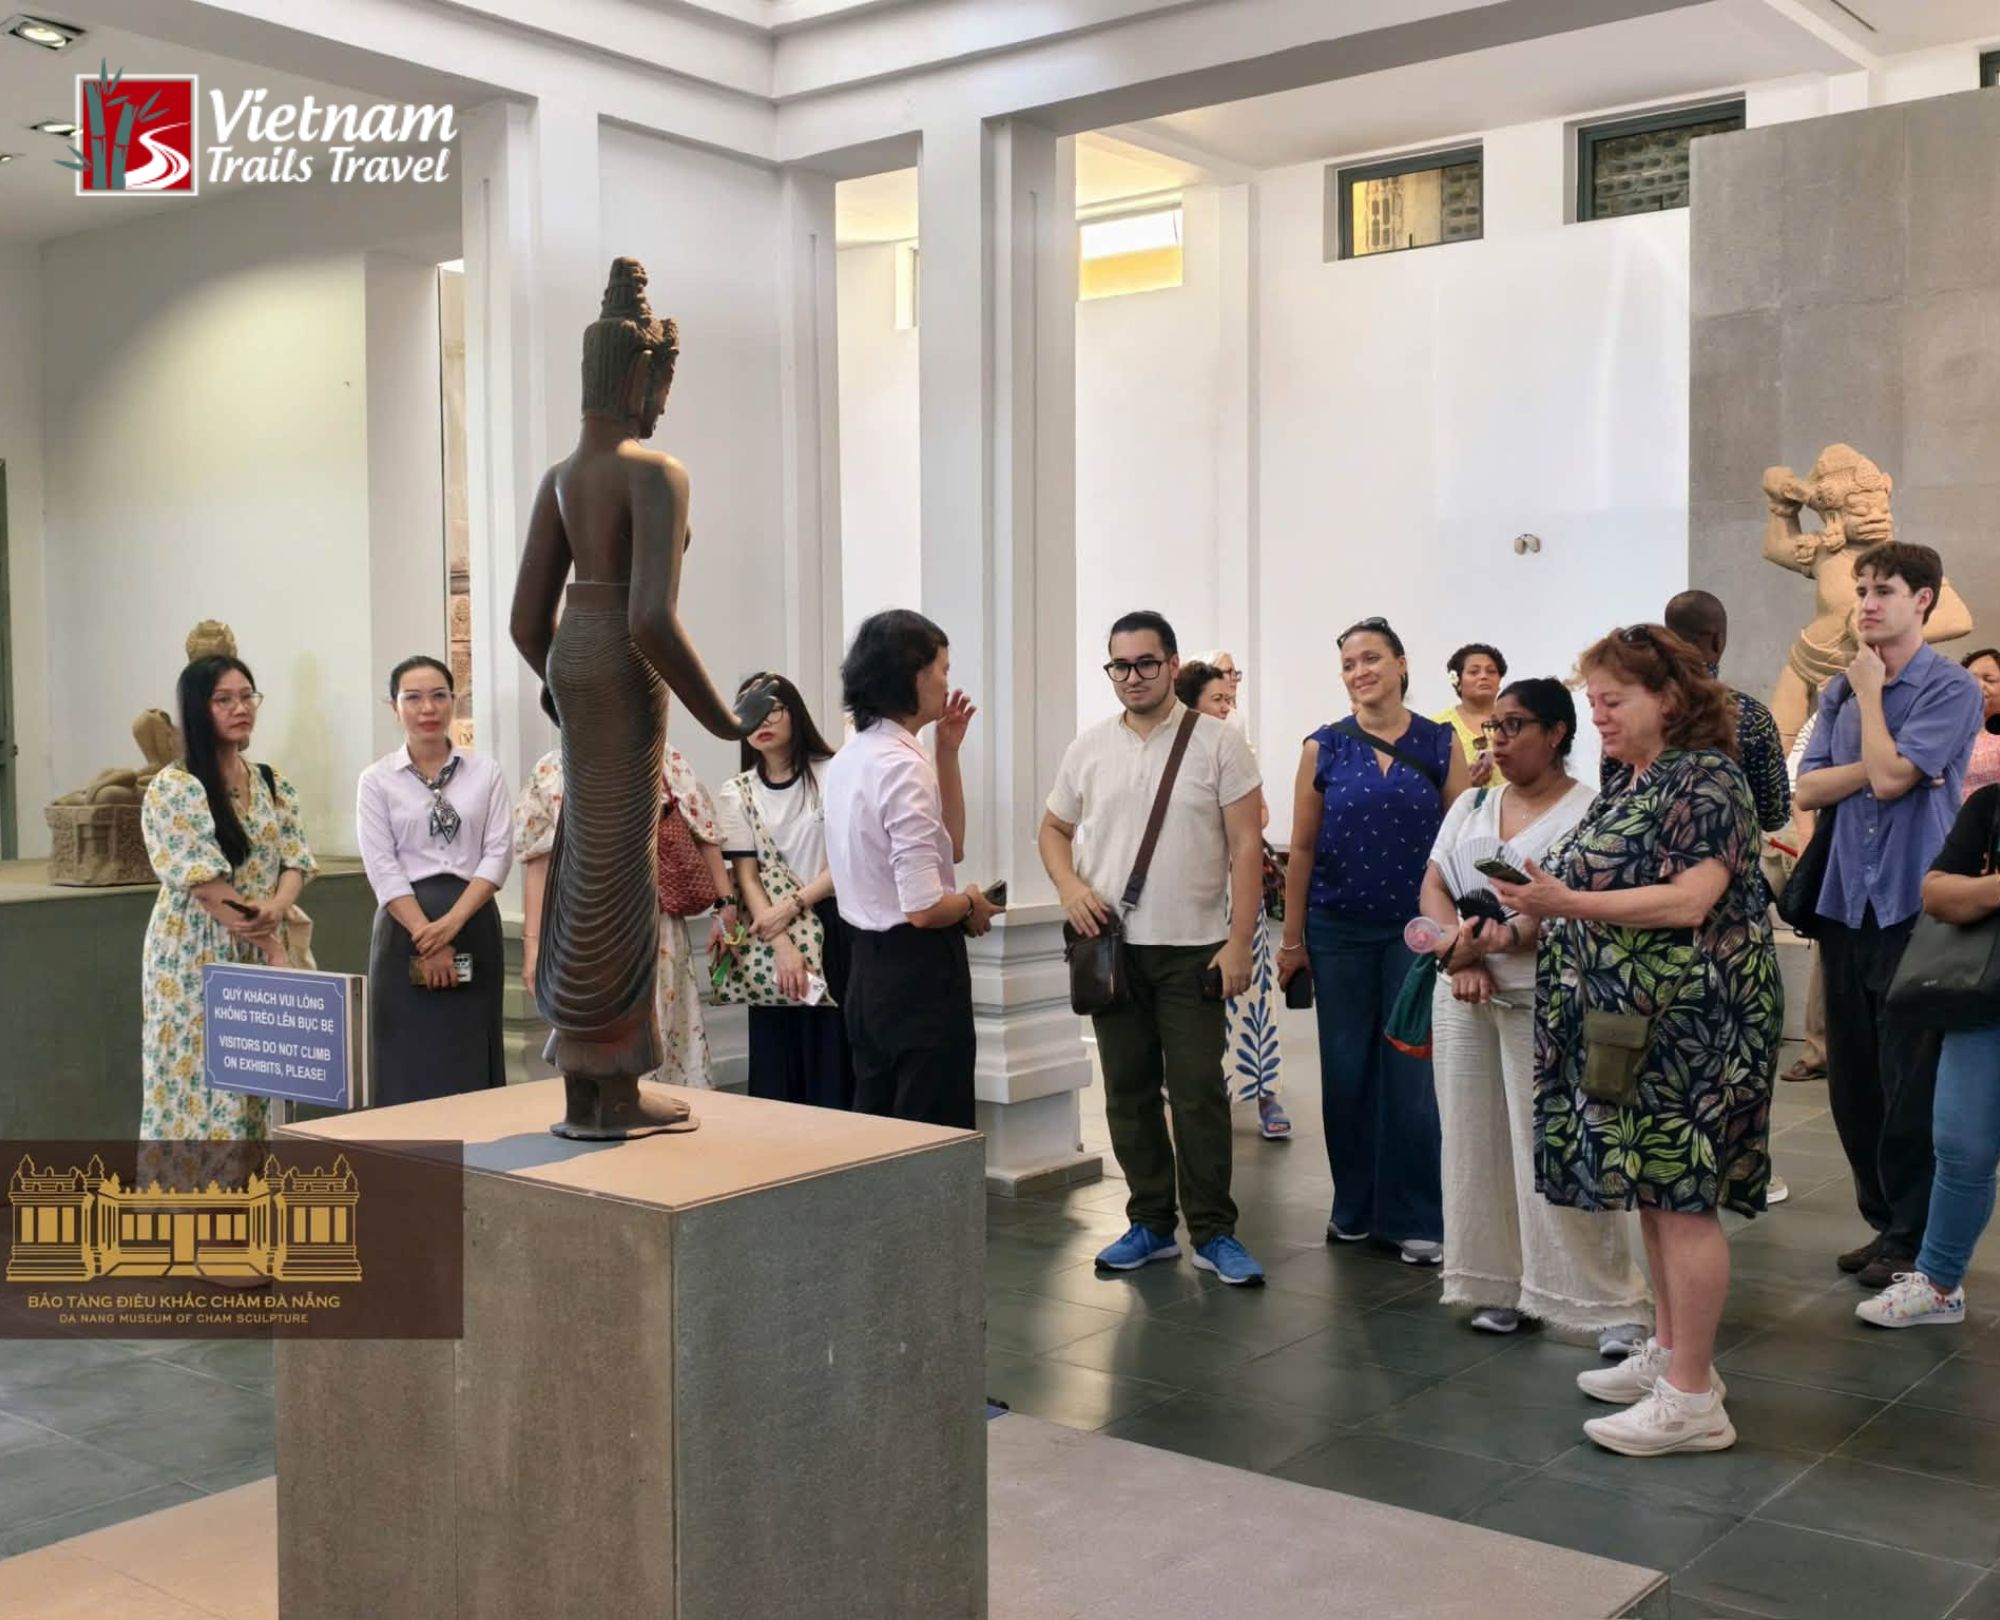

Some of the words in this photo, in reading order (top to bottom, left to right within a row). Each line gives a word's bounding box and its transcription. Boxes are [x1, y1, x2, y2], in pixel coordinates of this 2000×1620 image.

[244, 989, 277, 1005] KHÁCH
[278, 994, 295, 1008] VUI
[297, 993, 325, 1010] LÒNG
[214, 1005, 248, 1022] KHÔNG
[249, 1010, 275, 1025] TRÈO
[277, 1011, 296, 1028] LÊN
[298, 1018, 319, 1033] BỤC
[219, 1035, 261, 1051] VISITORS
[262, 1041, 277, 1054] DO
[278, 1043, 299, 1057] NOT
[301, 1046, 331, 1061] CLIMB
[224, 1055, 237, 1069] ON
[239, 1057, 285, 1078] EXHIBITS,
[285, 1064, 326, 1081] PLEASE!
